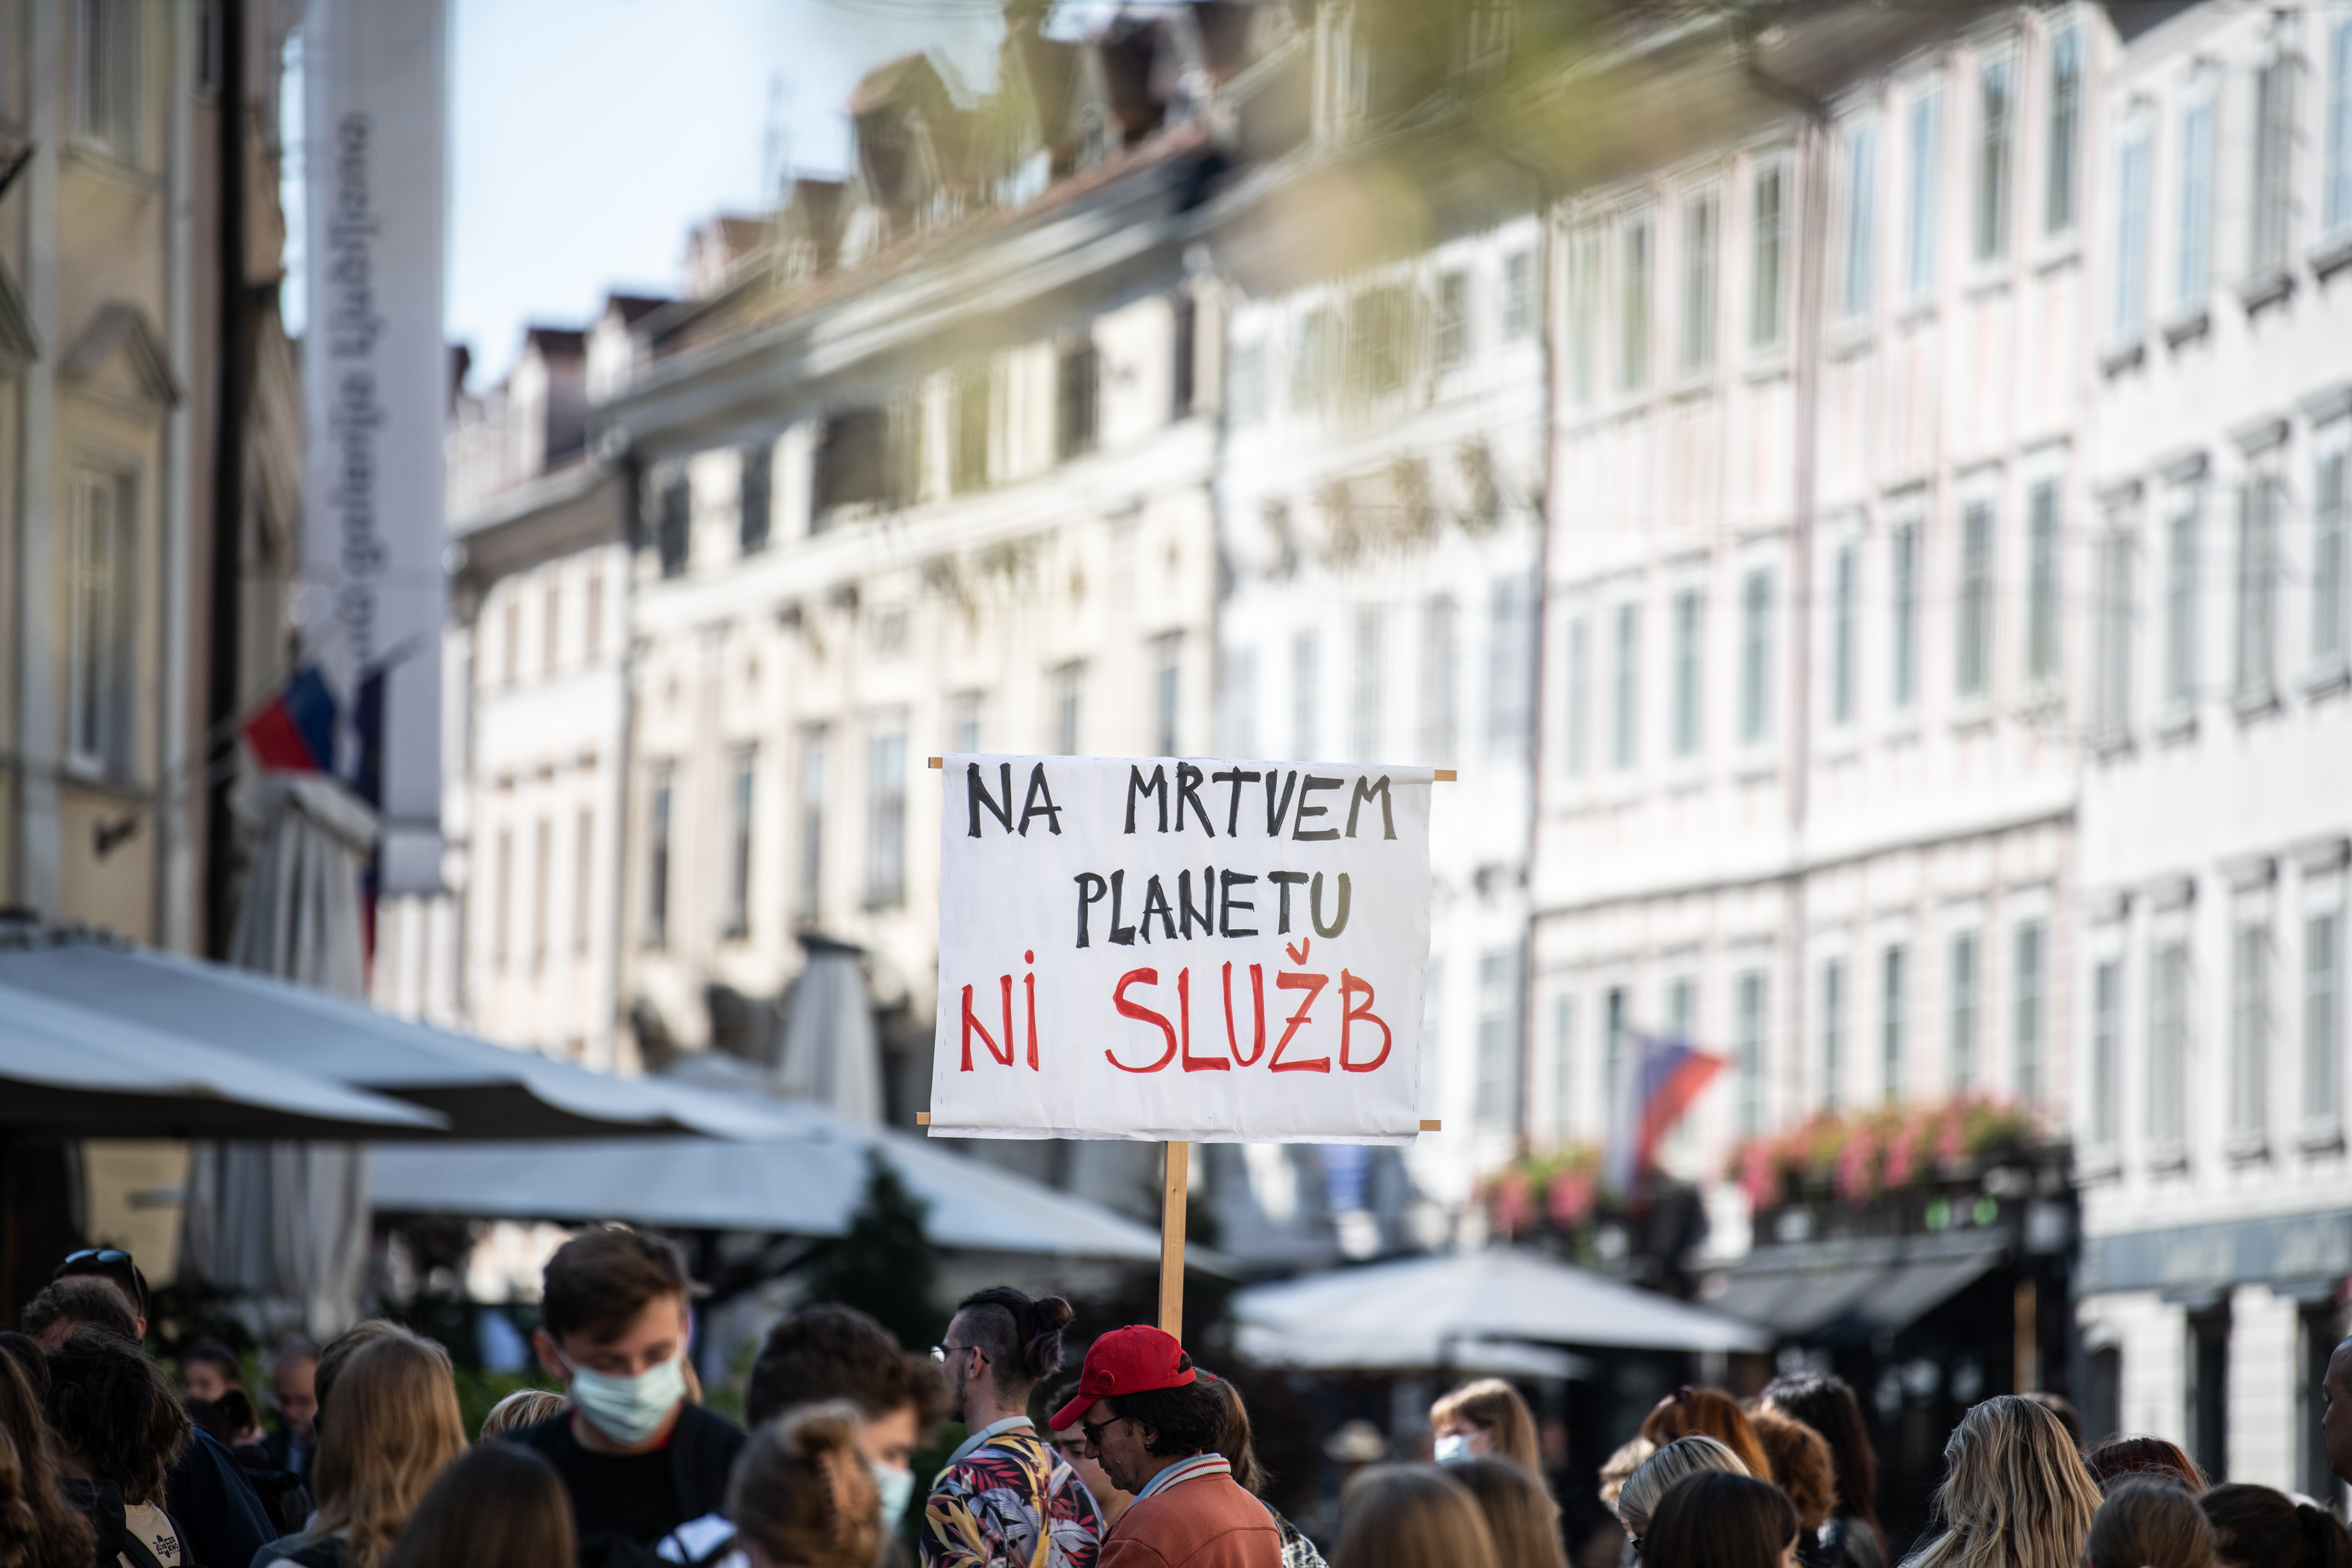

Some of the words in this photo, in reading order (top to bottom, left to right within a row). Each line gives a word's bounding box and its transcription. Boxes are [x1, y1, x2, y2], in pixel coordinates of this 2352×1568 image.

[967, 762, 1063, 838] NA
[1124, 761, 1398, 841] MRTVEM
[1074, 865, 1351, 949] PLANETU
[1104, 937, 1392, 1074] SLUŽB
